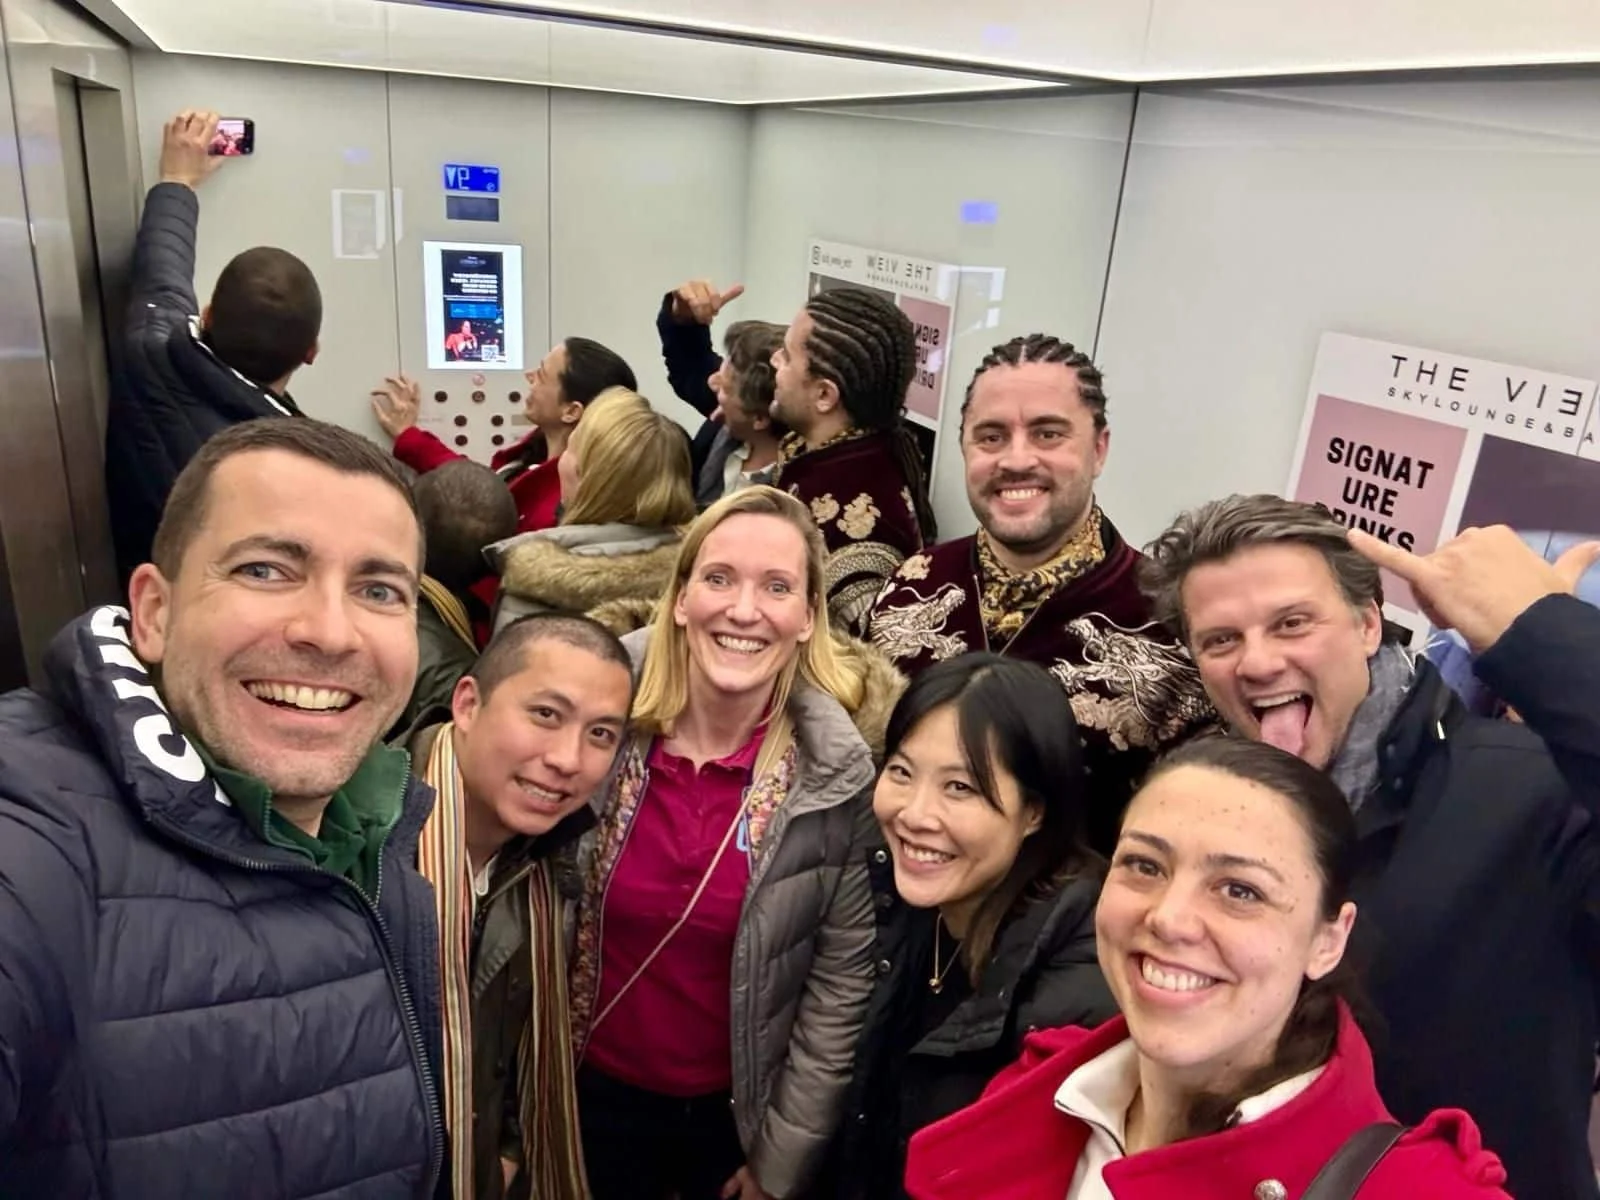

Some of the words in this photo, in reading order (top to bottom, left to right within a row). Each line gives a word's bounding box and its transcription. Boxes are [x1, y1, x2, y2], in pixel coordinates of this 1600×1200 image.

[1391, 354, 1469, 392] THE
[1327, 437, 1435, 489] SIGNAT
[1342, 476, 1399, 517] URE
[1315, 501, 1415, 553] RINKS
